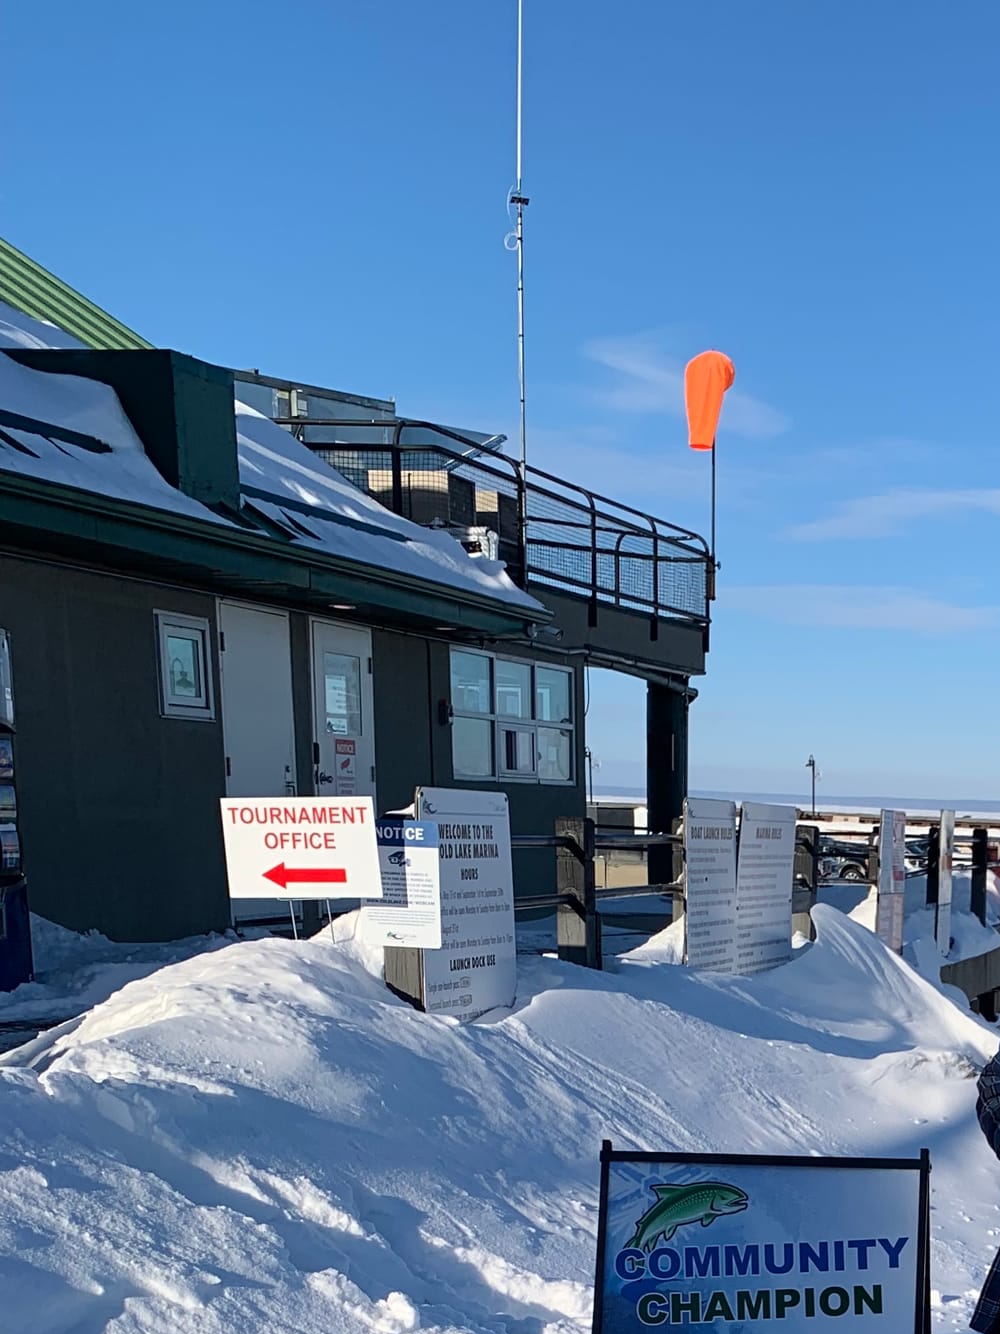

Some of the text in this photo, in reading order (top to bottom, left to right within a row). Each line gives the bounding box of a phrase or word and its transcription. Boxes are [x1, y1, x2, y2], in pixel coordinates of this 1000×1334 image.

[227, 807, 367, 824] TOURNAMENT
[376, 826, 424, 840] NOTICE
[438, 824, 493, 839] WELCOME TO THE
[264, 832, 336, 849] OFFICE
[440, 843, 499, 858] OLD LAKE MARINA
[460, 868, 478, 880] HOURS
[449, 954, 496, 971] LAUNCH DOCK USE
[615, 1237, 909, 1280] COMMUNITY
[637, 1284, 883, 1325] CHAMPION
